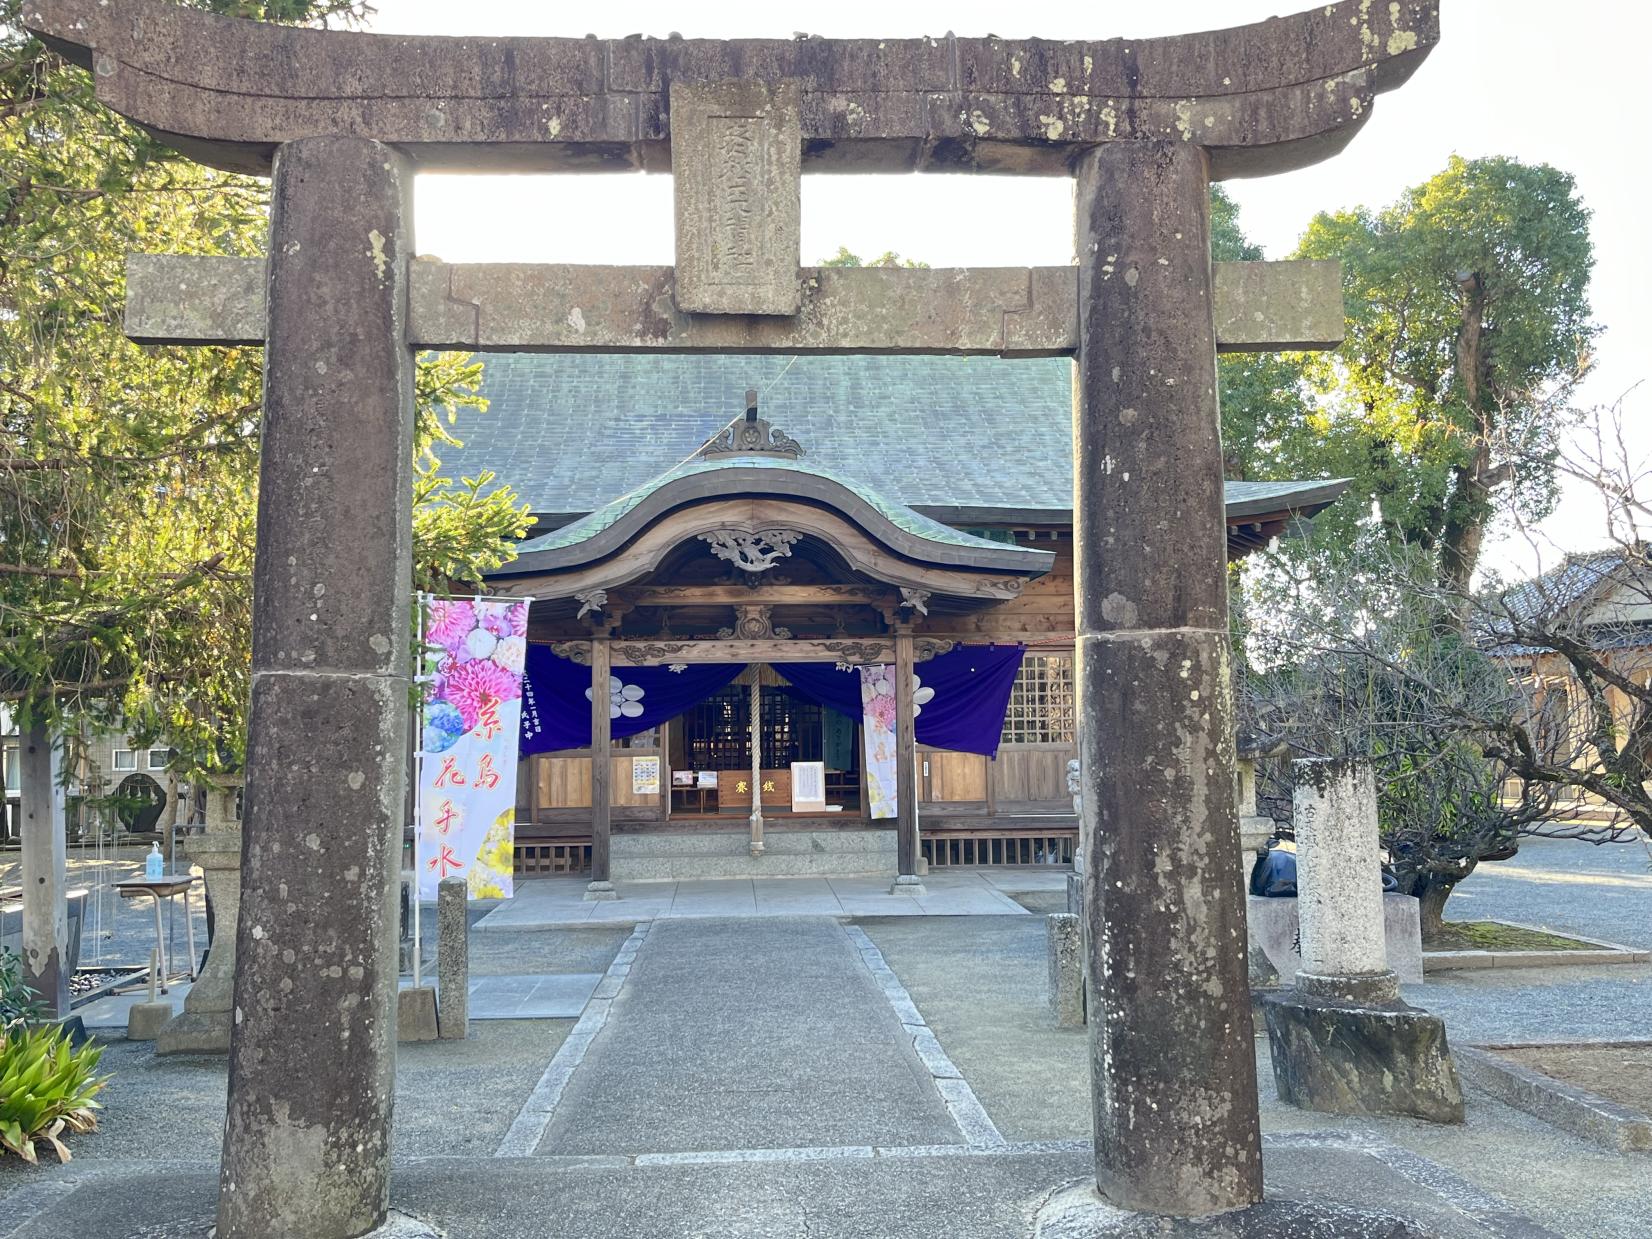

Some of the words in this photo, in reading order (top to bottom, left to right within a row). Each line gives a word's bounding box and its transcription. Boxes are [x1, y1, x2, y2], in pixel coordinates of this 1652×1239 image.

[473, 696, 502, 790] 糸島
[428, 757, 466, 878] 花手水
